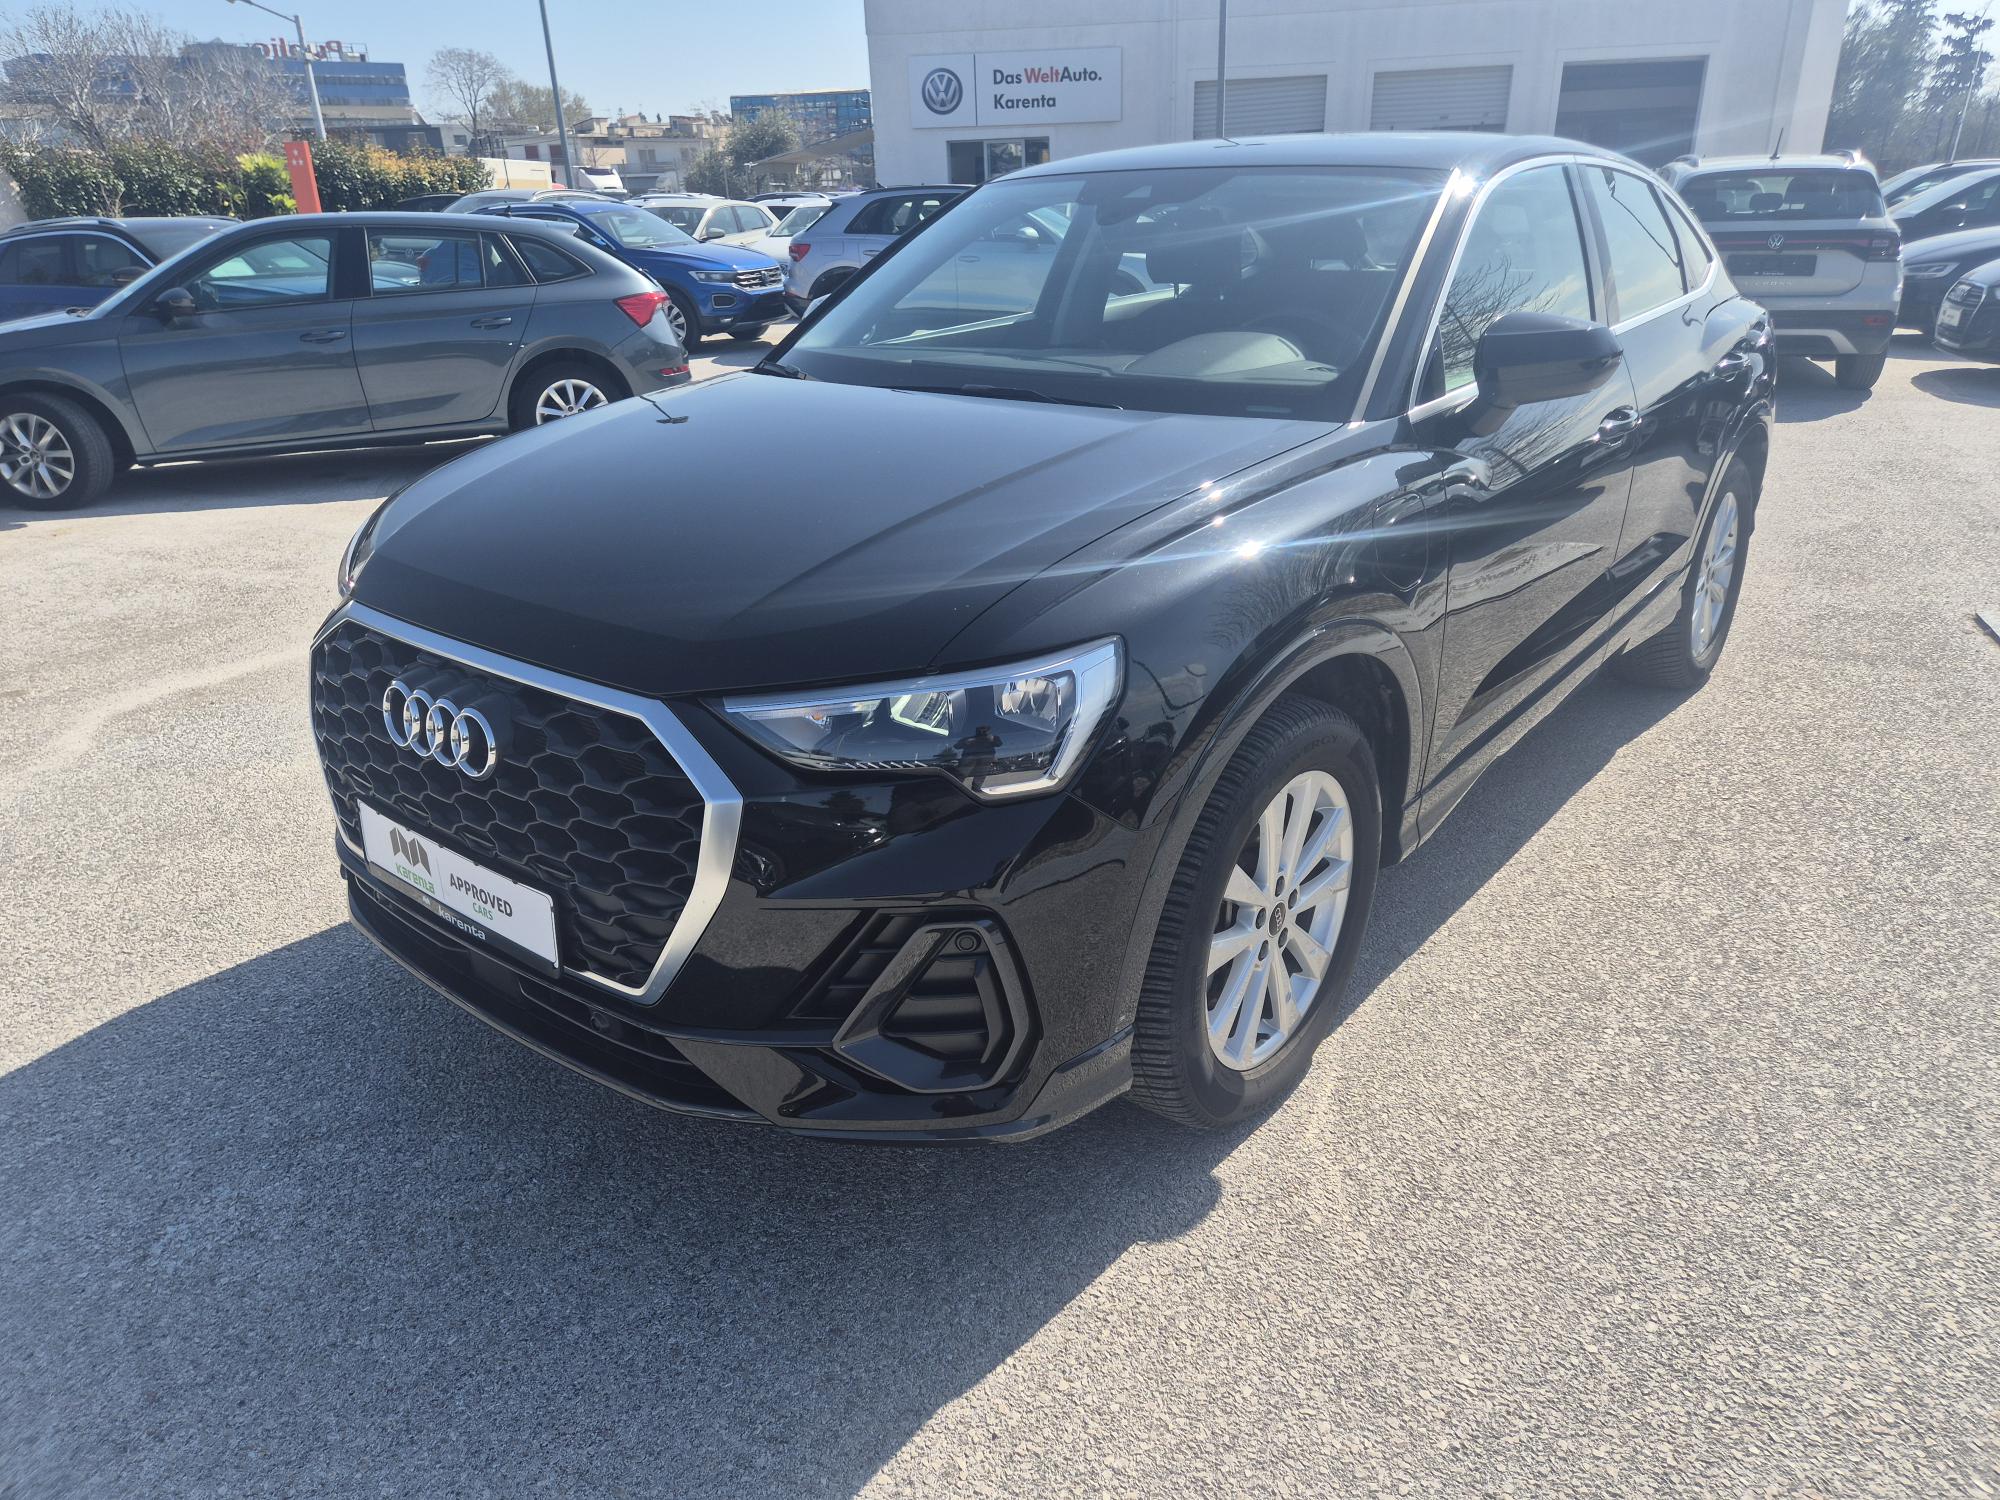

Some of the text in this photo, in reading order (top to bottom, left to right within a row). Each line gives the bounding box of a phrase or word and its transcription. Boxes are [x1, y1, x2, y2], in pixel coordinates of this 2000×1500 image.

[993, 66, 1102, 85] Das WeltAuto.
[994, 93, 1056, 109] Karenta
[449, 873, 513, 917] APPROVED
[472, 902, 494, 921] CARS
[438, 905, 486, 941] karenta
